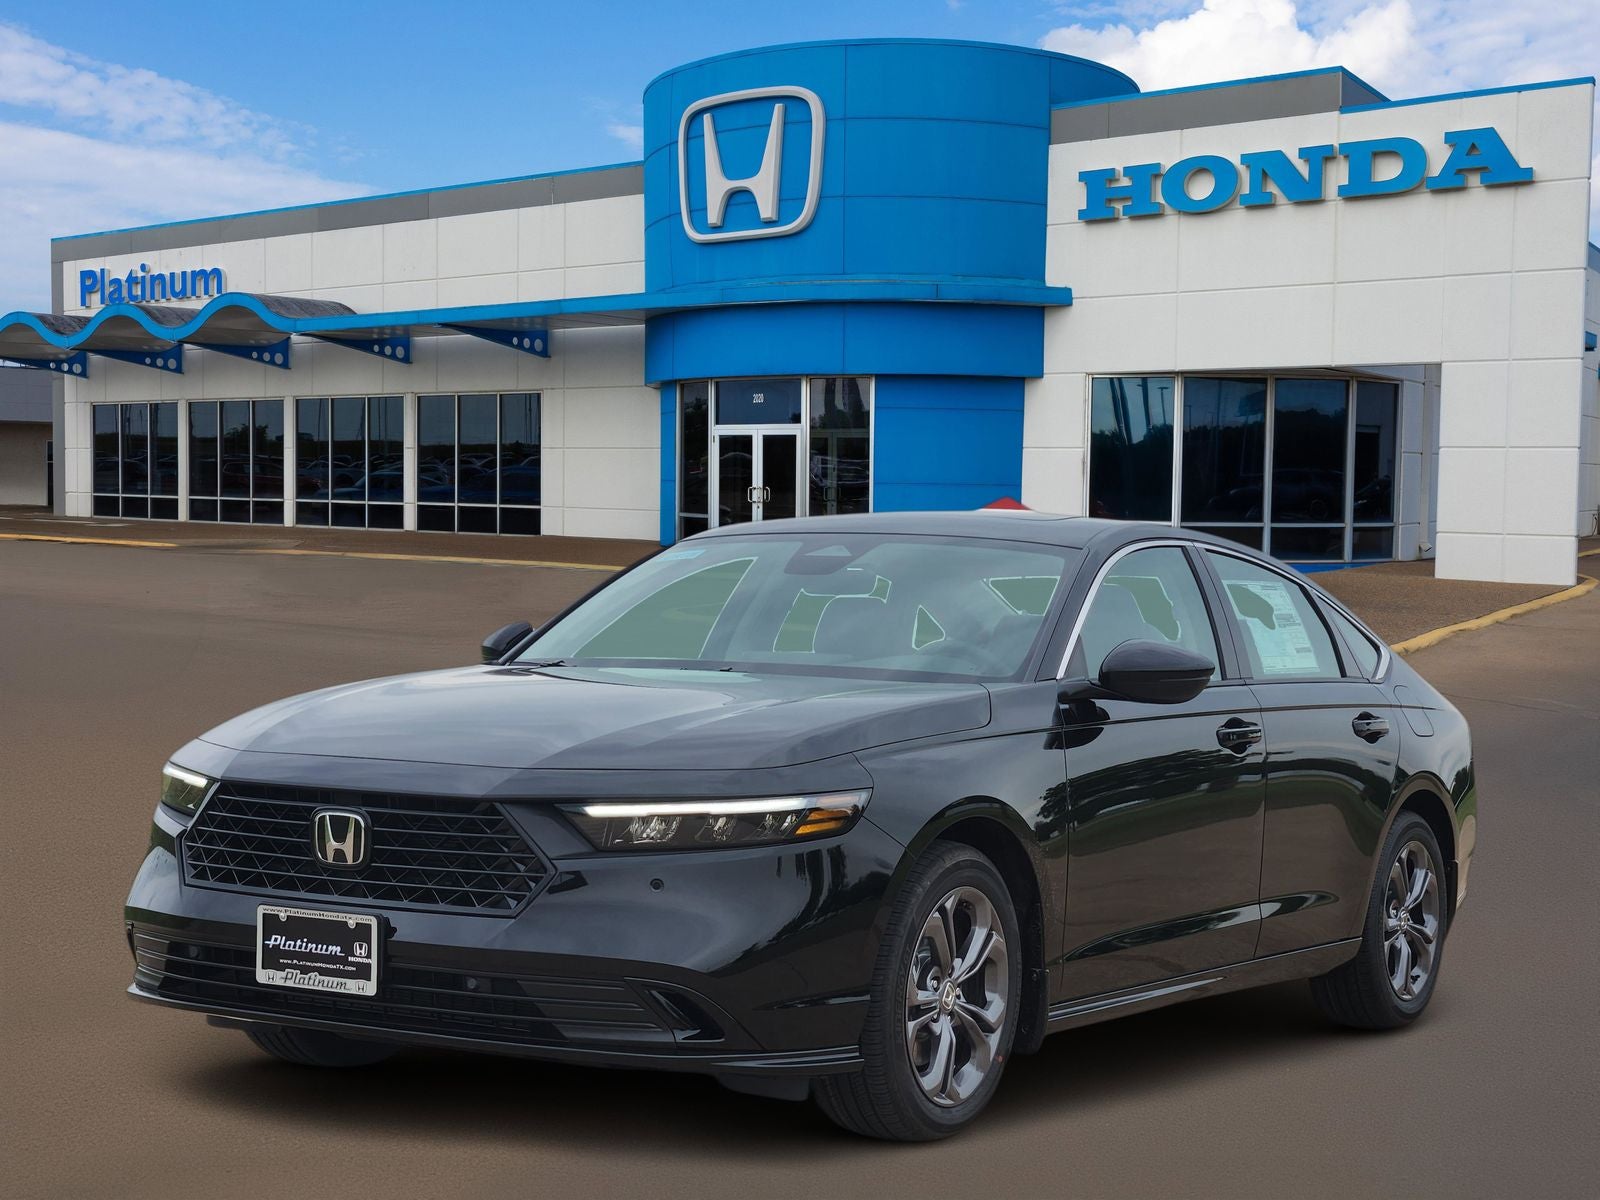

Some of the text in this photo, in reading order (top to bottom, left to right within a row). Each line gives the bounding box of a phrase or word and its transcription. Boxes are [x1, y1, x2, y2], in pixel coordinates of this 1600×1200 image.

[1078, 126, 1534, 222] HONDA
[79, 262, 226, 307] Platinum
[265, 935, 345, 956] Platinum
[280, 970, 351, 991] Platinum
